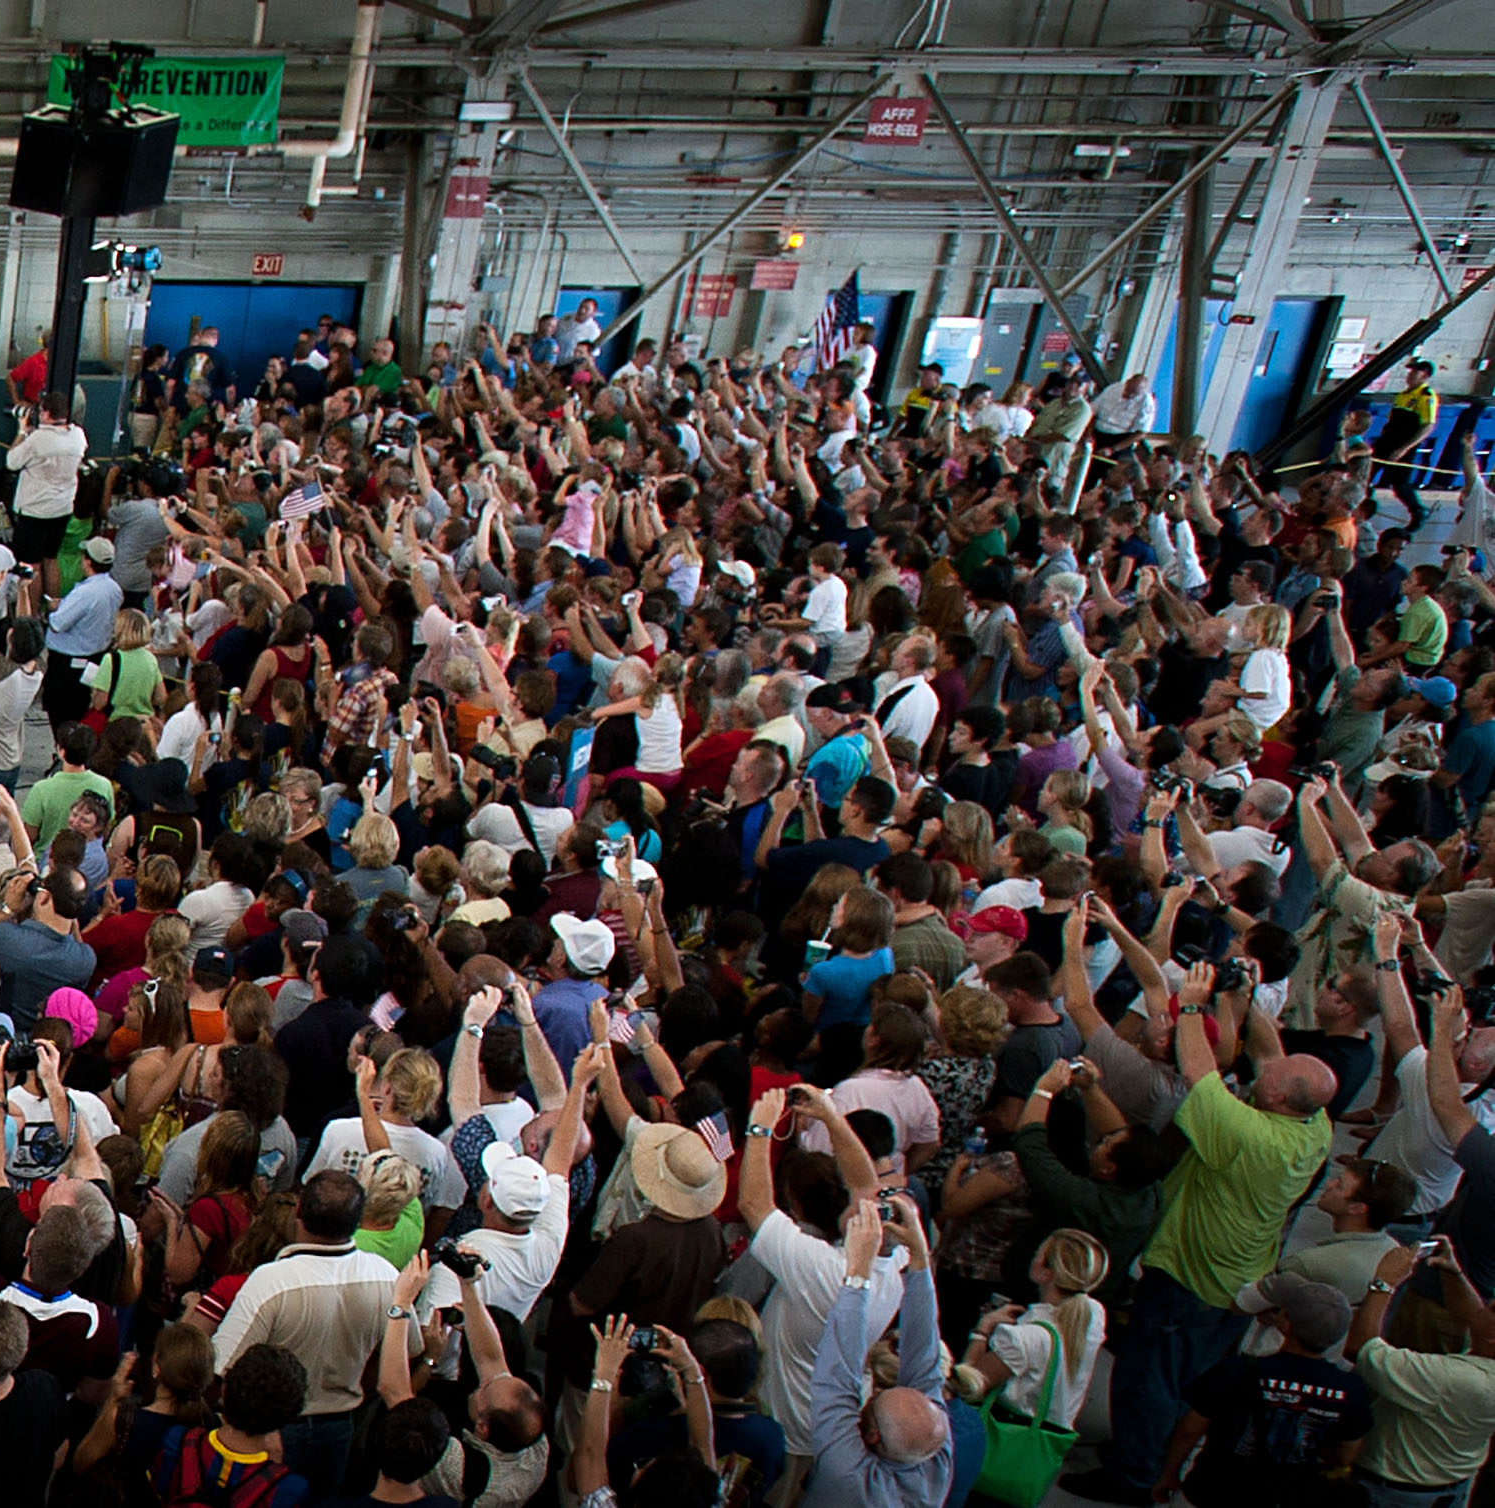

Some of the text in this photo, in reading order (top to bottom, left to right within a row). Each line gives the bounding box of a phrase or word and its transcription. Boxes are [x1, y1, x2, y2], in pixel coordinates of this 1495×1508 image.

[881, 108, 916, 120] AFFF
[868, 122, 894, 136] HOSE
[253, 255, 283, 272] EXIT
